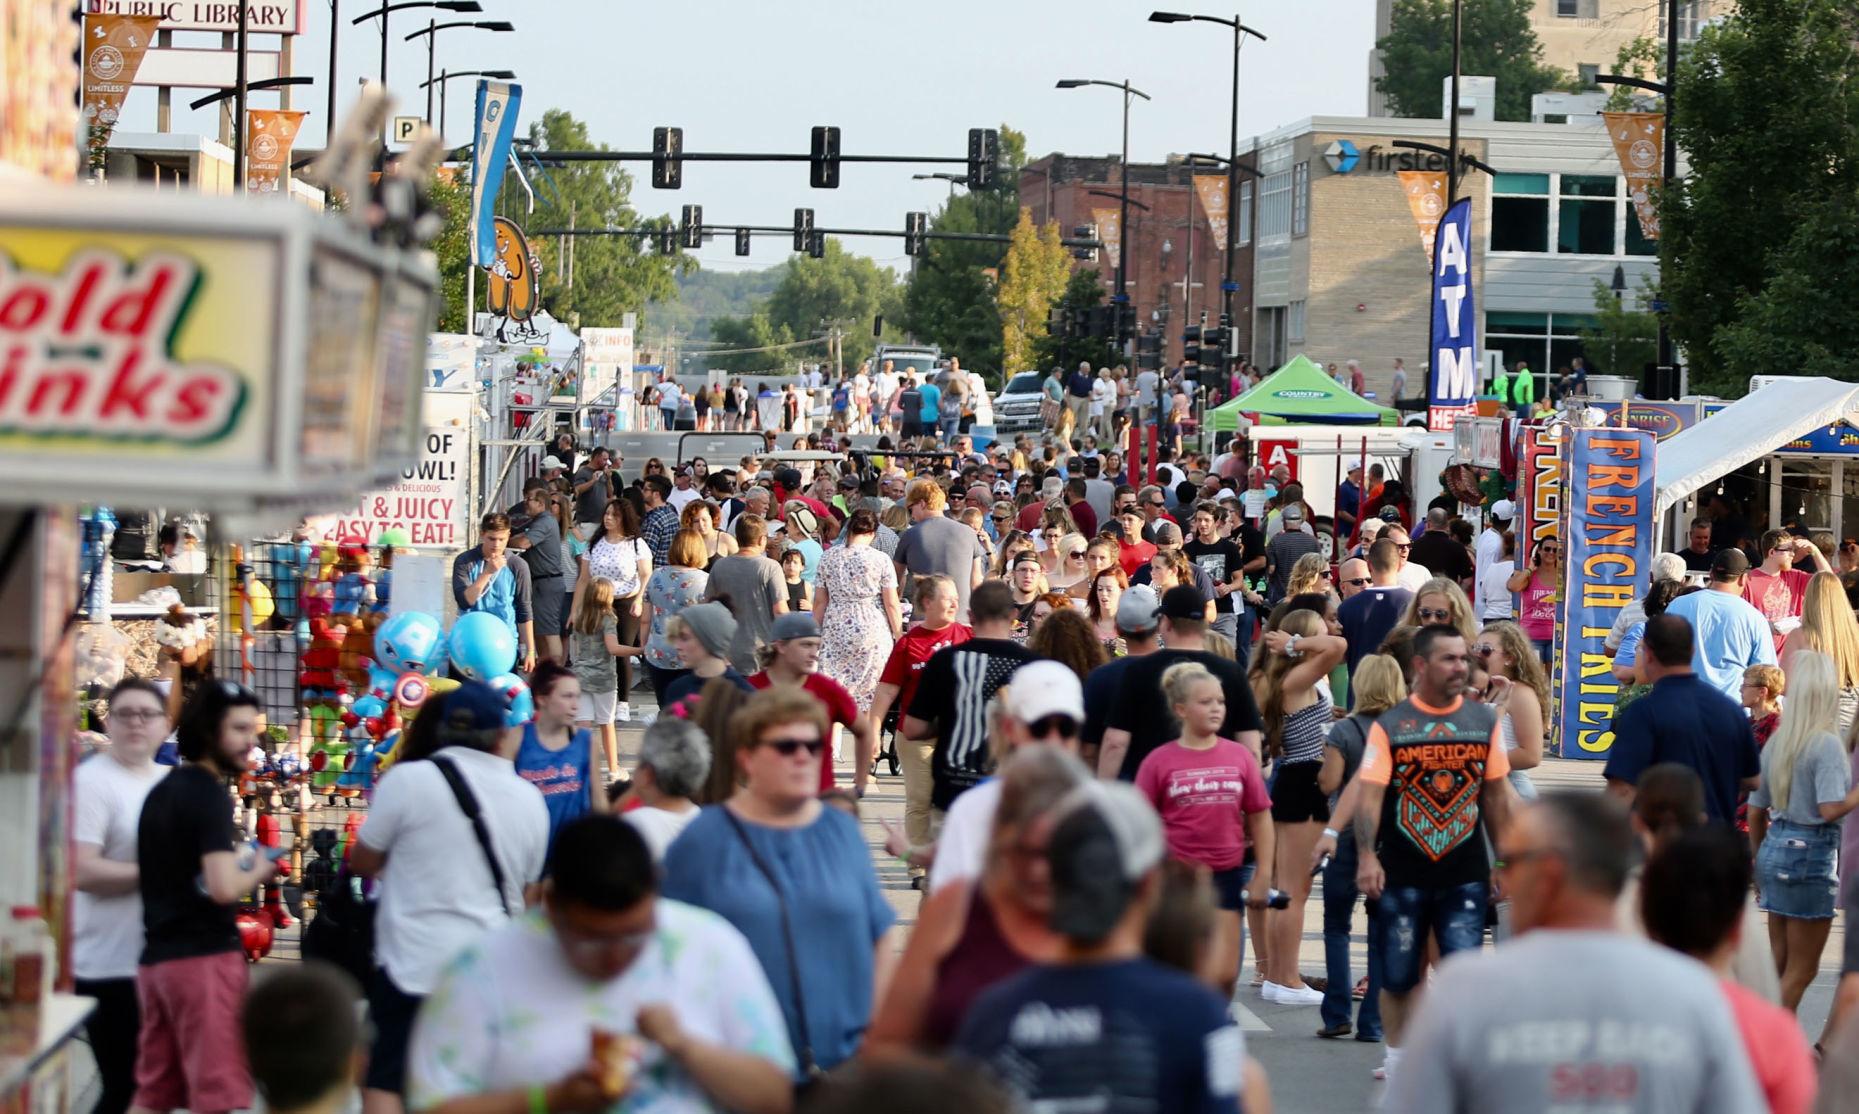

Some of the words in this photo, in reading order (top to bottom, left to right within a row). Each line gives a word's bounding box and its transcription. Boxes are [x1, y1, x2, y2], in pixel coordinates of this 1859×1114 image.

[194, 4, 287, 25] LIBRARY
[402, 123, 412, 138] P
[0, 262, 172, 334] old
[1438, 222, 1473, 399] ATM
[0, 345, 222, 424] inks
[427, 434, 453, 454] OF
[401, 461, 455, 480] OWL!
[403, 484, 441, 492] DELICIOUS
[373, 497, 388, 518] &
[394, 498, 453, 519] JUICY
[1582, 437, 1640, 608] FRENCH
[411, 523, 454, 543] EAT!
[1397, 744, 1487, 762] AMERICAN
